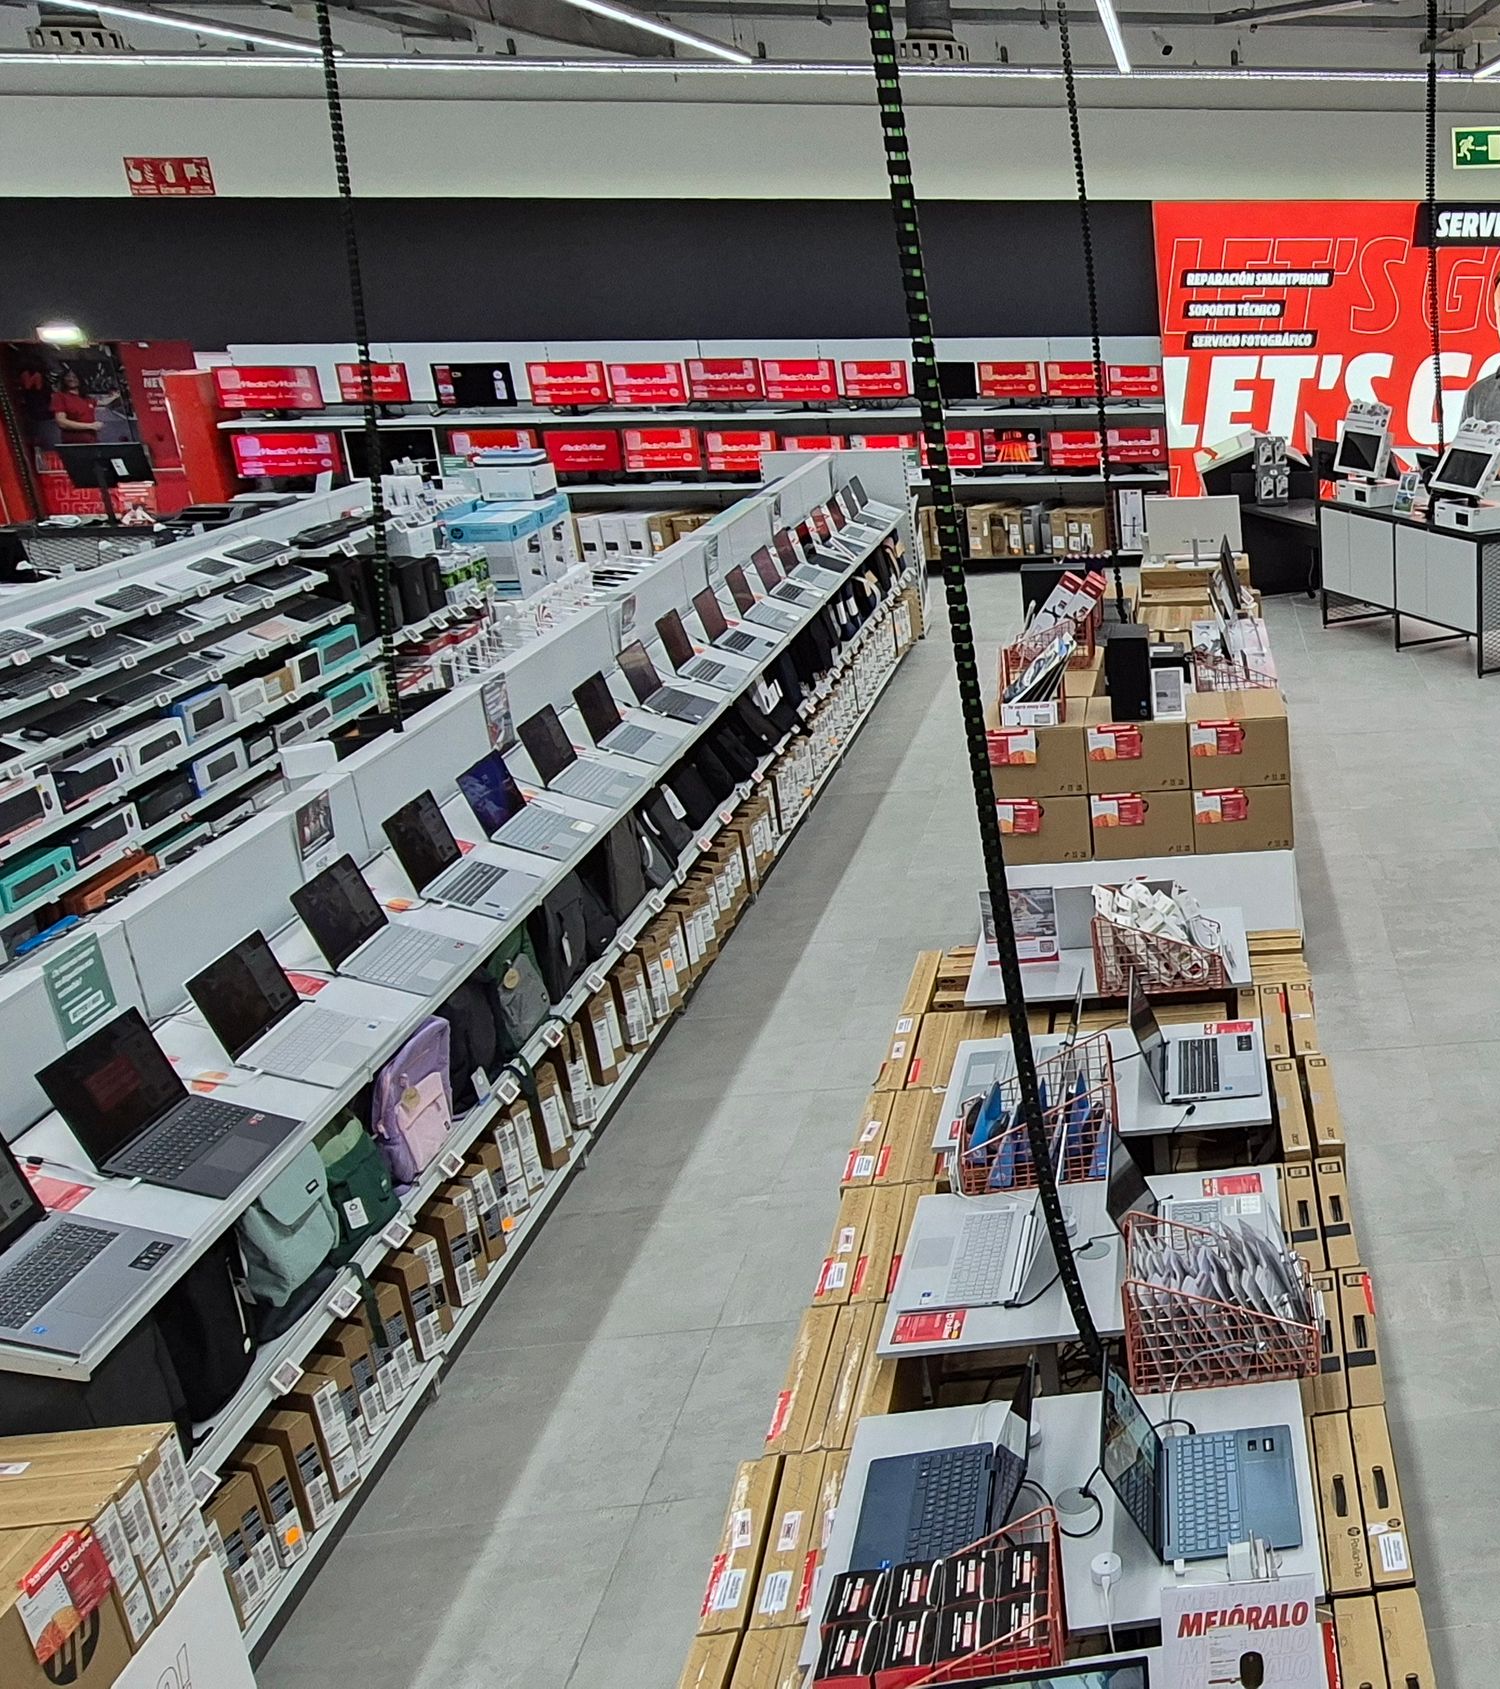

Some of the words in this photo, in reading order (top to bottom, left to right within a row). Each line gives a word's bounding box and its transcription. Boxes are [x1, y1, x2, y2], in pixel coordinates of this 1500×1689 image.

[1186, 271, 1255, 287] REPARACIÓN
[1255, 272, 1330, 287] SMARTPHONE
[1188, 303, 1236, 316] SOPORTE
[1237, 302, 1281, 316] TÉCNICO
[1192, 334, 1240, 347] SERVICIO
[1241, 332, 1313, 347] FOTOGRÁFICO
[1163, 352, 1394, 449] LET'S
[1177, 1600, 1310, 1639] MEJÓRALO
